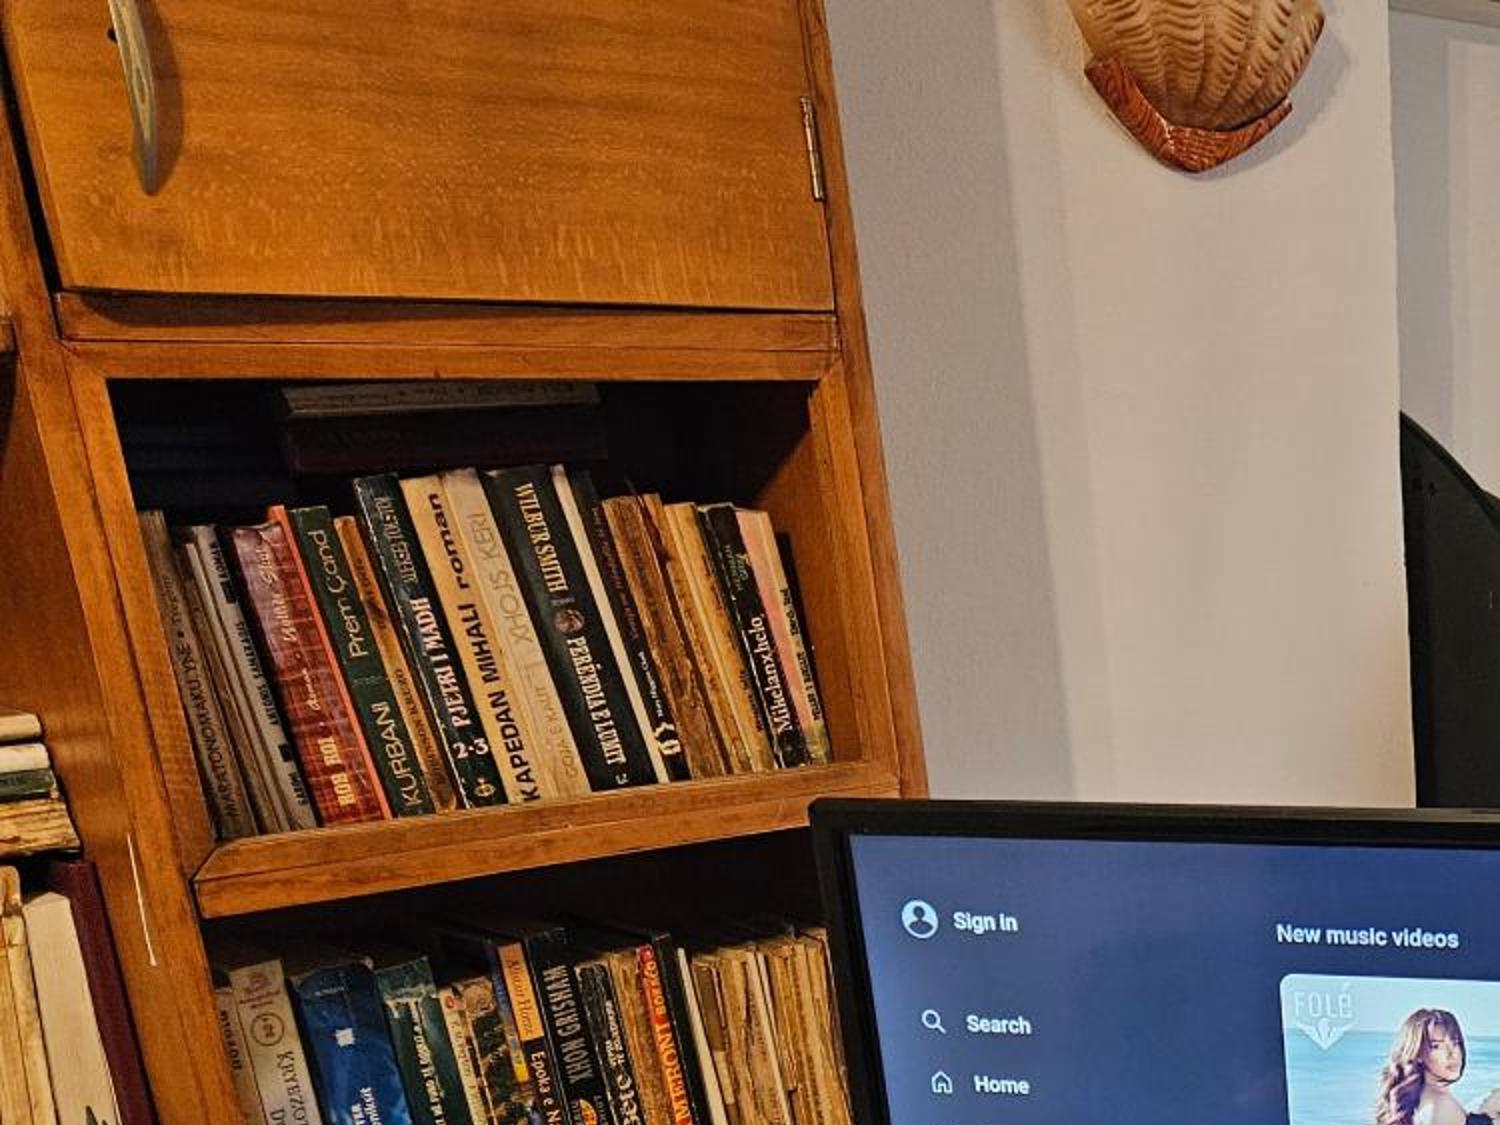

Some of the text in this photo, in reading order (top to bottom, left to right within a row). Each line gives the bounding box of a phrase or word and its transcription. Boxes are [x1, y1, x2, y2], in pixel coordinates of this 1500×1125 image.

[467, 512, 495, 562] KERI
[409, 597, 446, 657] MADH
[488, 569, 533, 645] XHOJS
[514, 482, 549, 545] WILBUR
[535, 544, 570, 594] SMITH
[596, 720, 627, 766] LUMIT
[308, 529, 422, 807] KURBANI Prem Çand
[428, 492, 540, 802] KAPEDAN MIHALI roman
[434, 662, 472, 728] PJETRI
[953, 912, 1018, 934] Sign in
[1276, 924, 1459, 948] New music videos
[542, 963, 581, 1036] GRISHAM
[966, 1015, 1032, 1034] Search
[530, 1050, 556, 1094] Epoka
[560, 1036, 594, 1083] XHON
[974, 1075, 1030, 1094] Home
